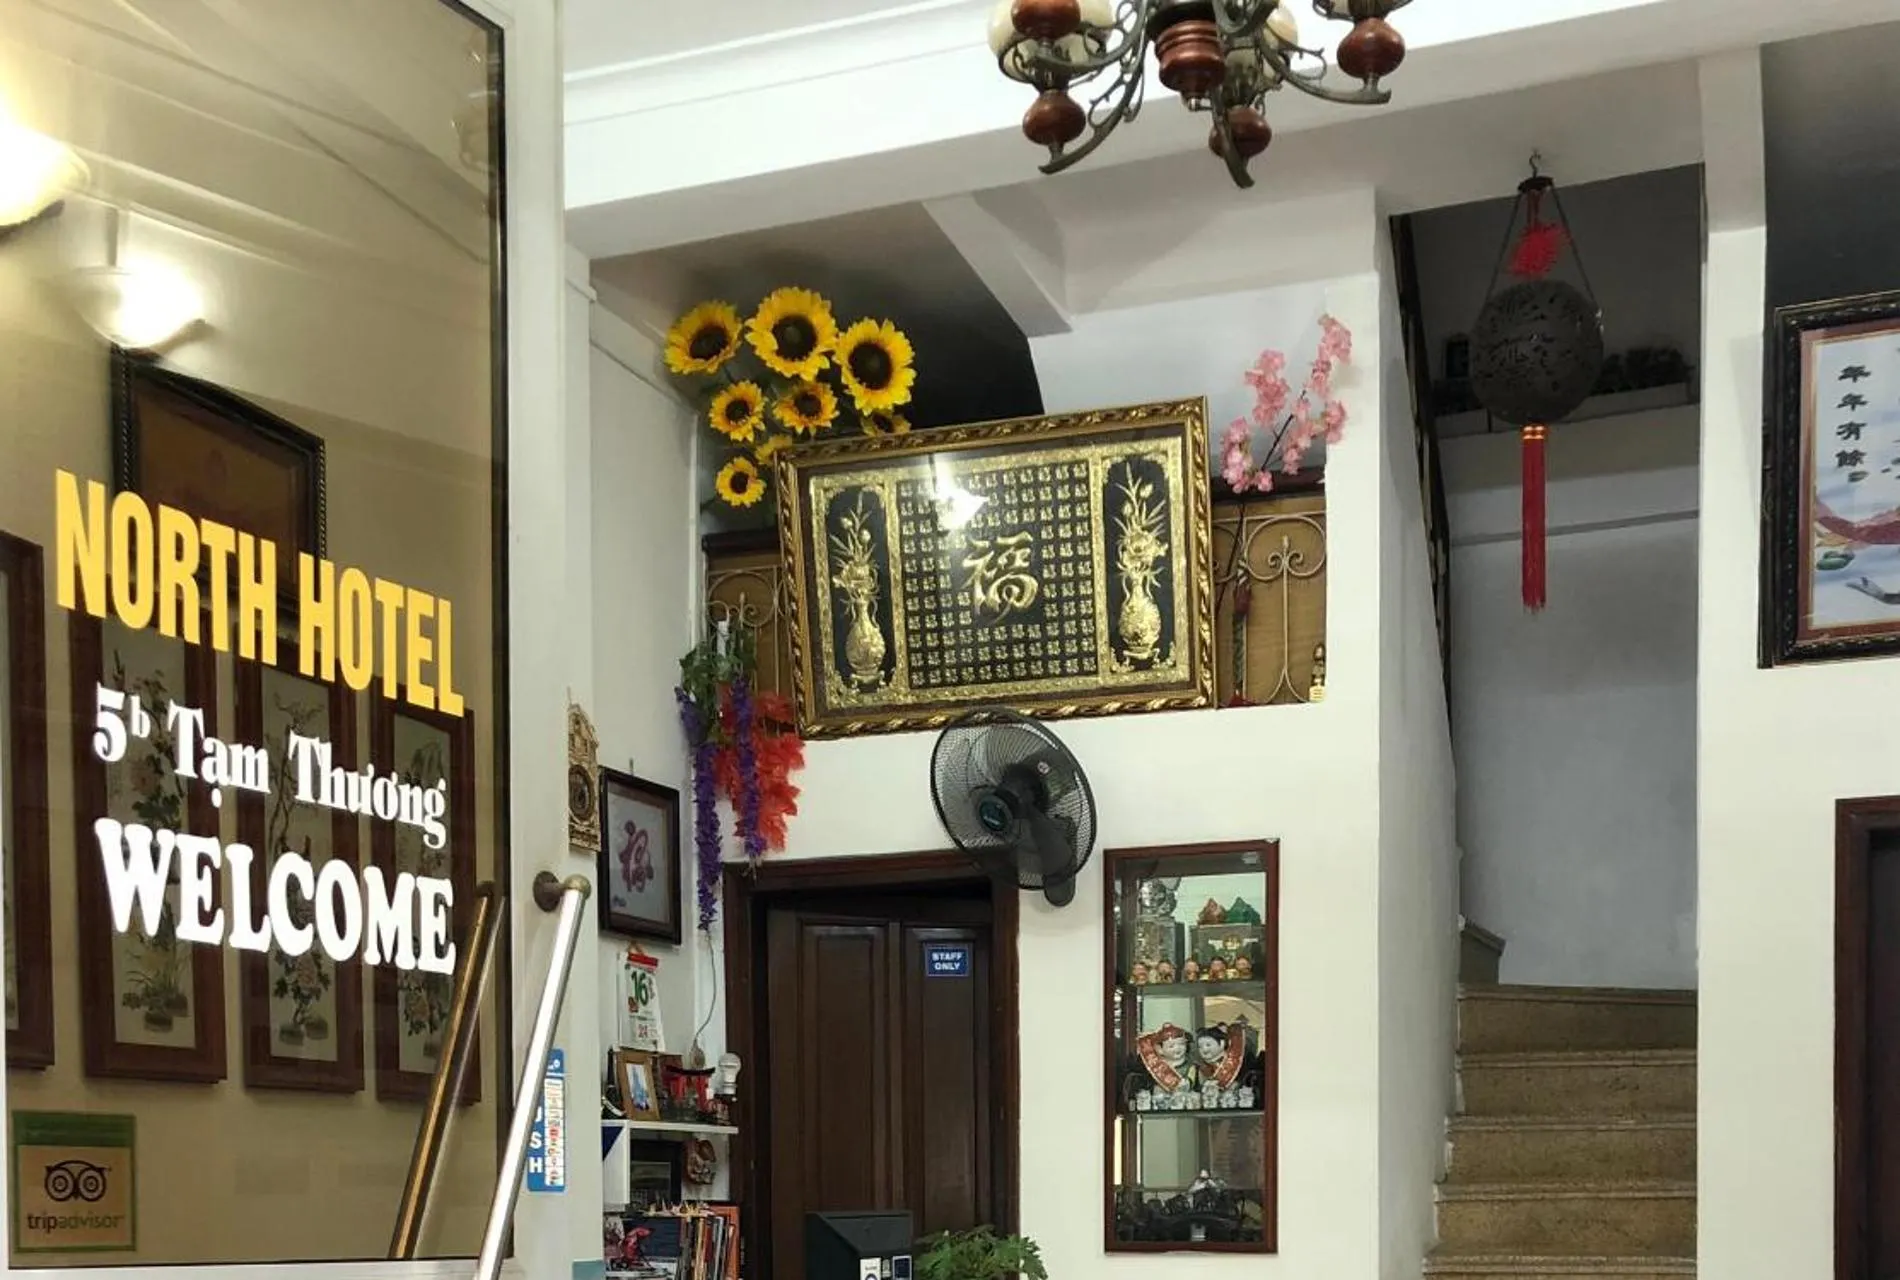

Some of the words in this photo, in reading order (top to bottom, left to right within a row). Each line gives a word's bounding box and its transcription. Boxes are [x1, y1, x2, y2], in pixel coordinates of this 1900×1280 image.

[55, 468, 277, 666] NORTH
[299, 551, 465, 718] HOTEL
[167, 698, 272, 809] Tạm
[287, 729, 447, 850] Thương
[93, 816, 458, 976] WELCOME
[931, 951, 964, 961] STAFF
[934, 961, 961, 971] ONLY
[630, 970, 649, 1007] 16
[26, 1211, 125, 1234] tripadvisor
